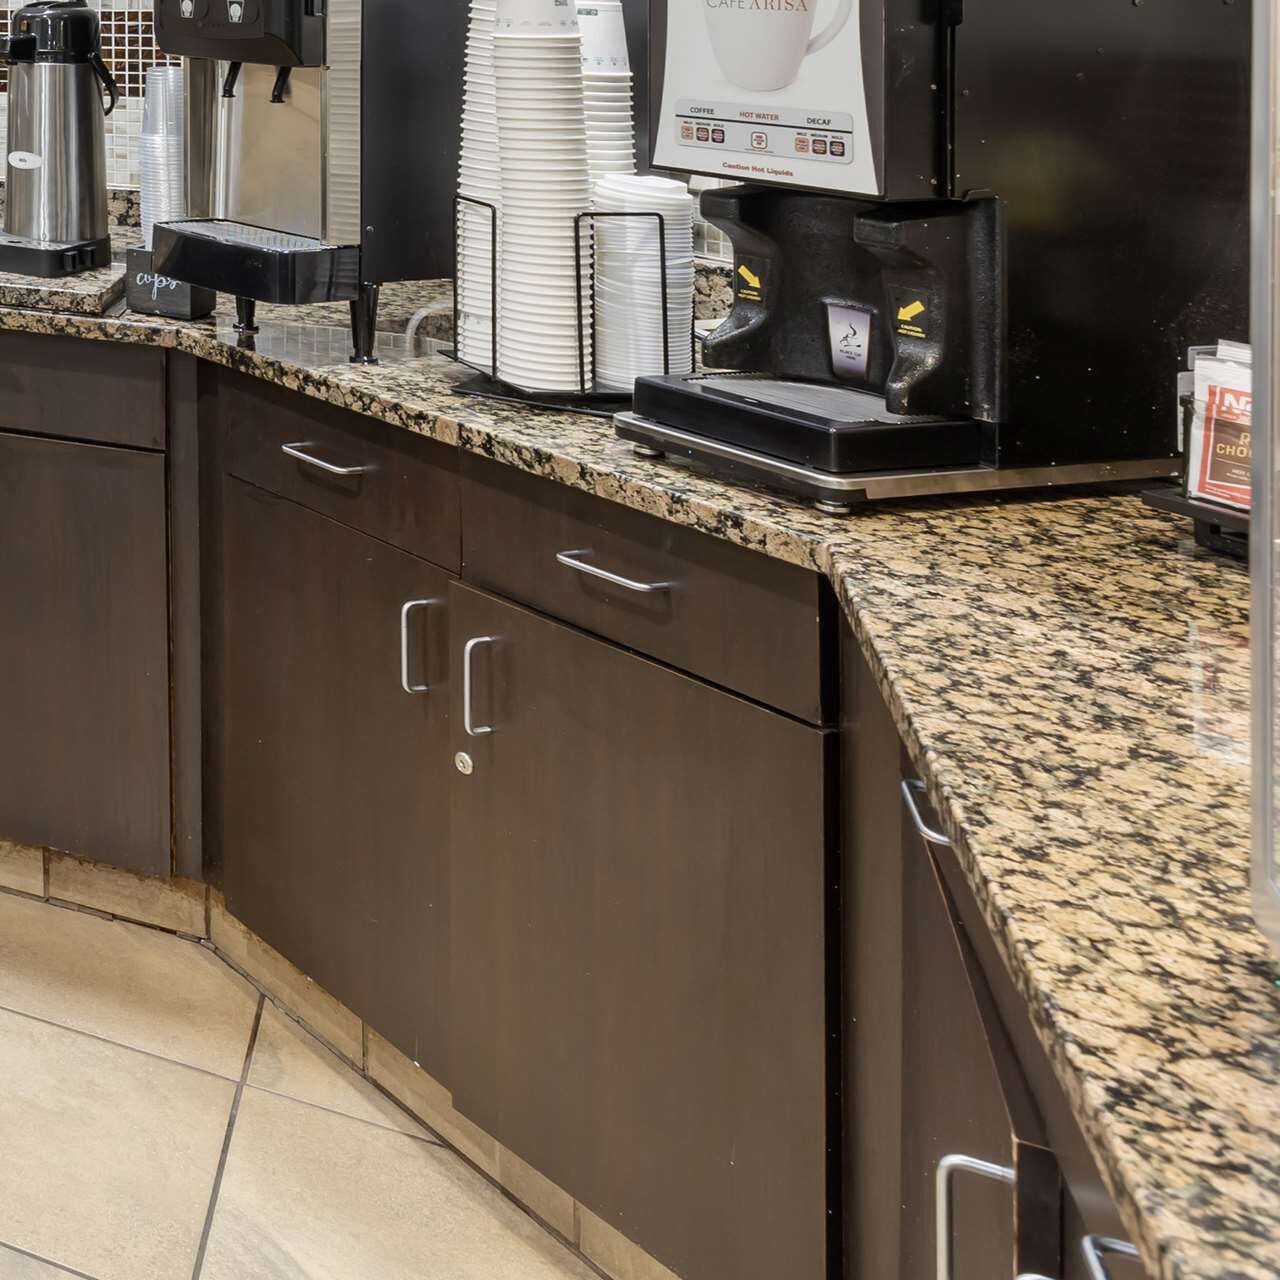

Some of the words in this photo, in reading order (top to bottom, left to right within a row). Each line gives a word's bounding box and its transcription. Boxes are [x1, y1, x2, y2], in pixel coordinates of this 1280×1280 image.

[690, 106, 715, 116] COFFEE
[739, 111, 754, 120] HOT
[754, 112, 780, 121] WATER
[806, 117, 832, 126] DECAF
[722, 162, 750, 172] Caution
[752, 165, 765, 174] Hot
[766, 166, 794, 178] Liquids
[136, 272, 182, 301] cups
[1216, 443, 1251, 458] CHO
